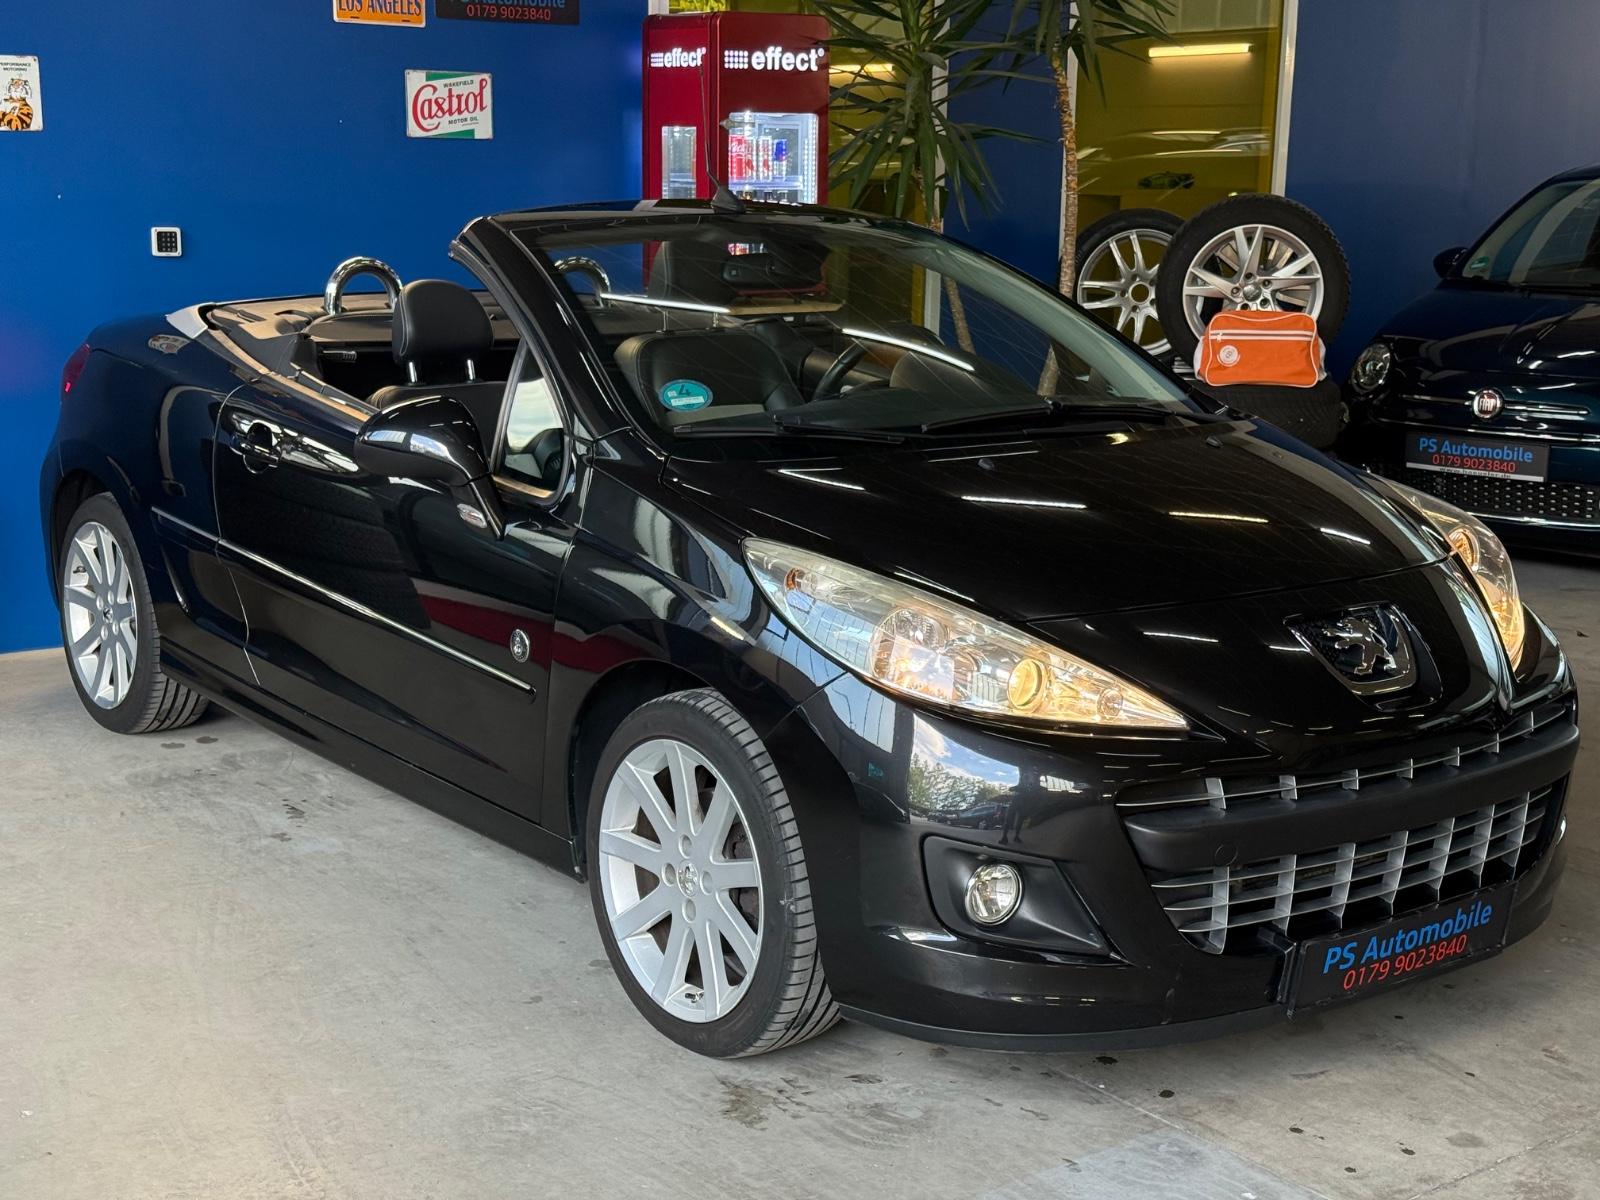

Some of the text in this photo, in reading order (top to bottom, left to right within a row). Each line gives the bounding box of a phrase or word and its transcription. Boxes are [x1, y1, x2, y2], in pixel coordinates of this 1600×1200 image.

[367, 0, 422, 16] ANGELES
[466, 4, 552, 20] 0179 9023840
[751, 46, 818, 71] effect
[443, 80, 474, 88] WAKEFIELD
[412, 78, 488, 132] Castrol
[448, 117, 468, 125] MOTOR
[1479, 395, 1495, 412] FIAT
[1419, 438, 1533, 463] PS Automobile
[1432, 454, 1516, 473] 0179 9023840
[1322, 901, 1492, 974] PS Automobile
[1343, 934, 1468, 990] 0179 9023840
